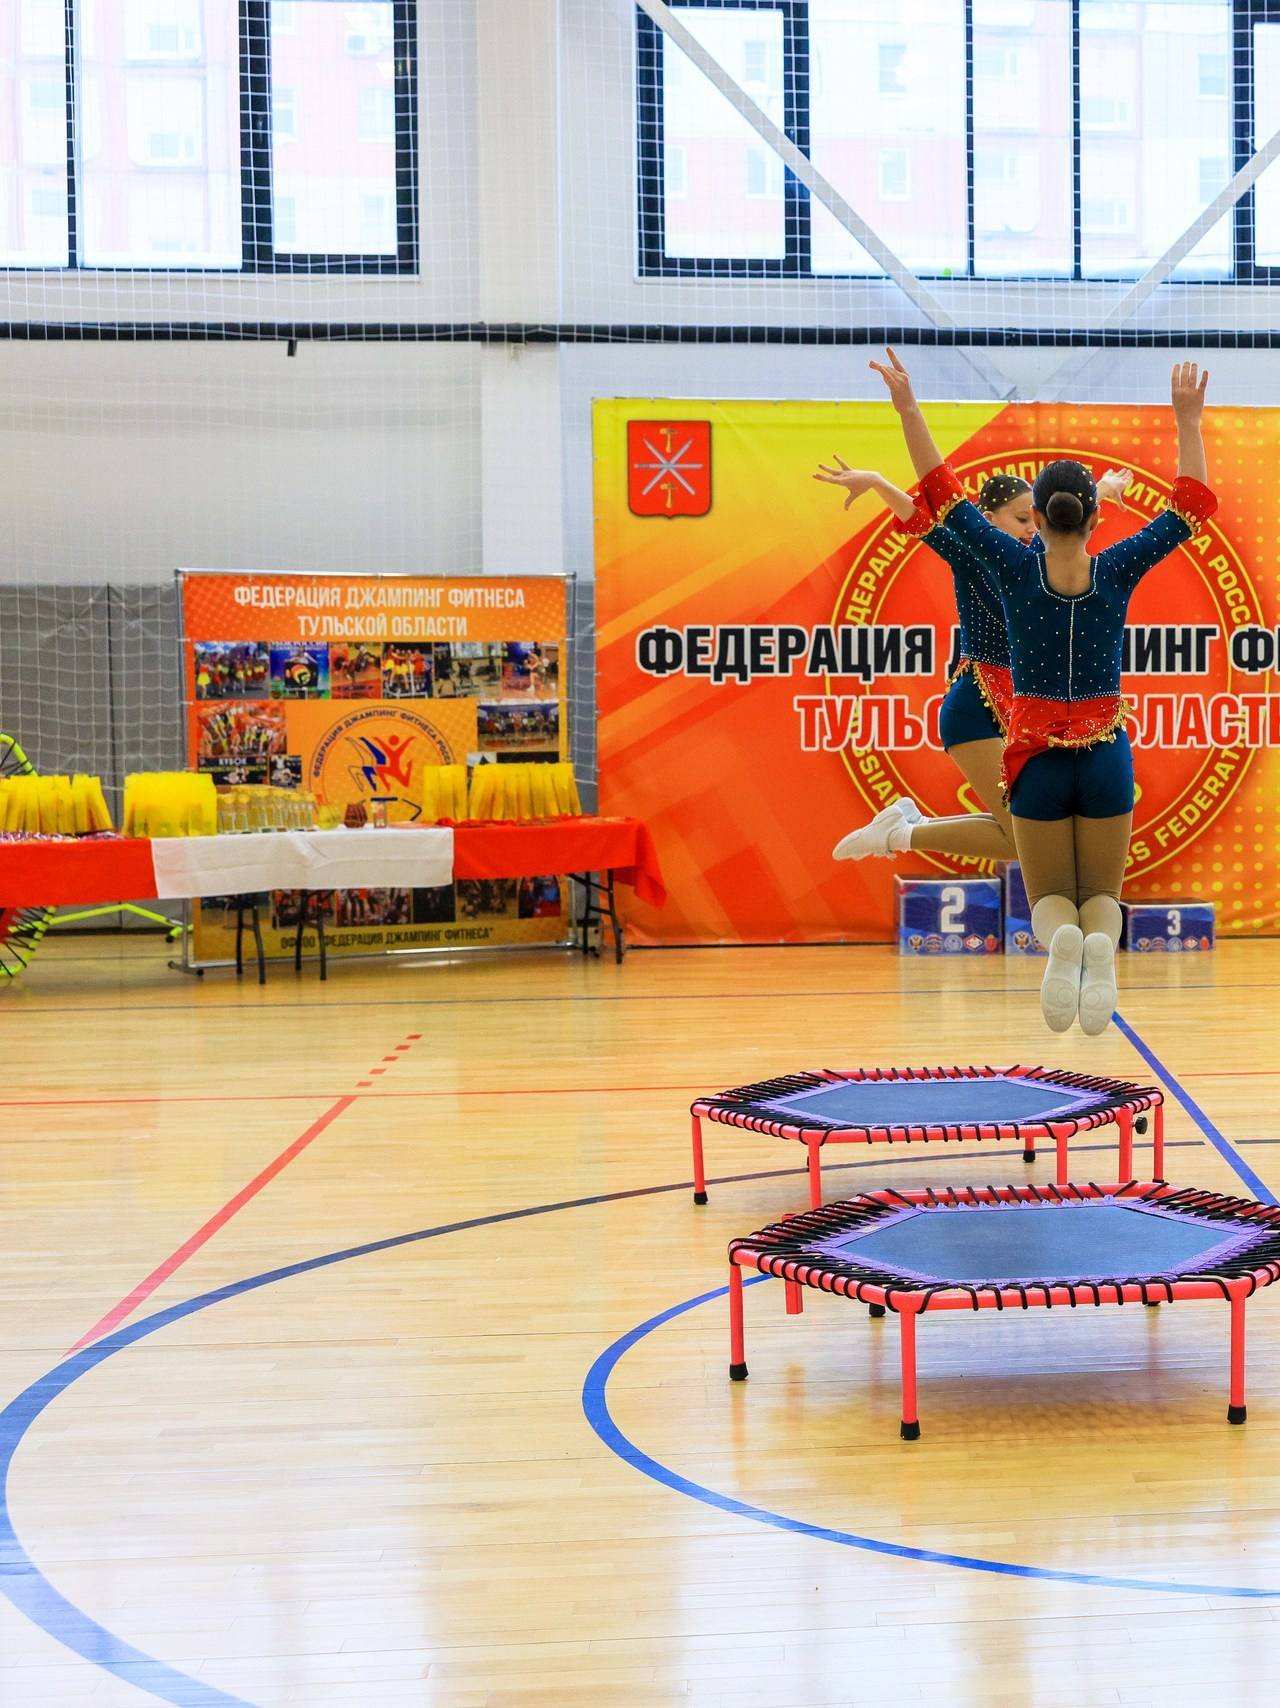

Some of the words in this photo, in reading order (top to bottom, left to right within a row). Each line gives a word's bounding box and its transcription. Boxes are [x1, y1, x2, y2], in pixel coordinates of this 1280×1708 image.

[234, 585, 341, 609] ФЕДЕРАЦИЯ
[345, 587, 443, 609] ДЖАМПИНГ
[448, 588, 525, 608] ФИТНЕСА
[1208, 554, 1253, 629] РОСС
[298, 613, 387, 637] ТУЛЬСКОЙ
[392, 616, 468, 637] ОБЛАСТИ
[636, 625, 936, 684] ФЕДЕРАЦИЯ
[313, 726, 344, 778] ФЕДЕРАЦИЯ
[344, 709, 397, 729] ДЖАМПИНГ
[400, 712, 438, 743] ФИТНЕСА
[794, 695, 943, 751] ТУЛЬС
[940, 887, 965, 933] 2
[1166, 910, 1181, 935] 3
[385, 929, 442, 945] ДЖАМПИНГ
[444, 926, 494, 940] ФИТНЕСА"
